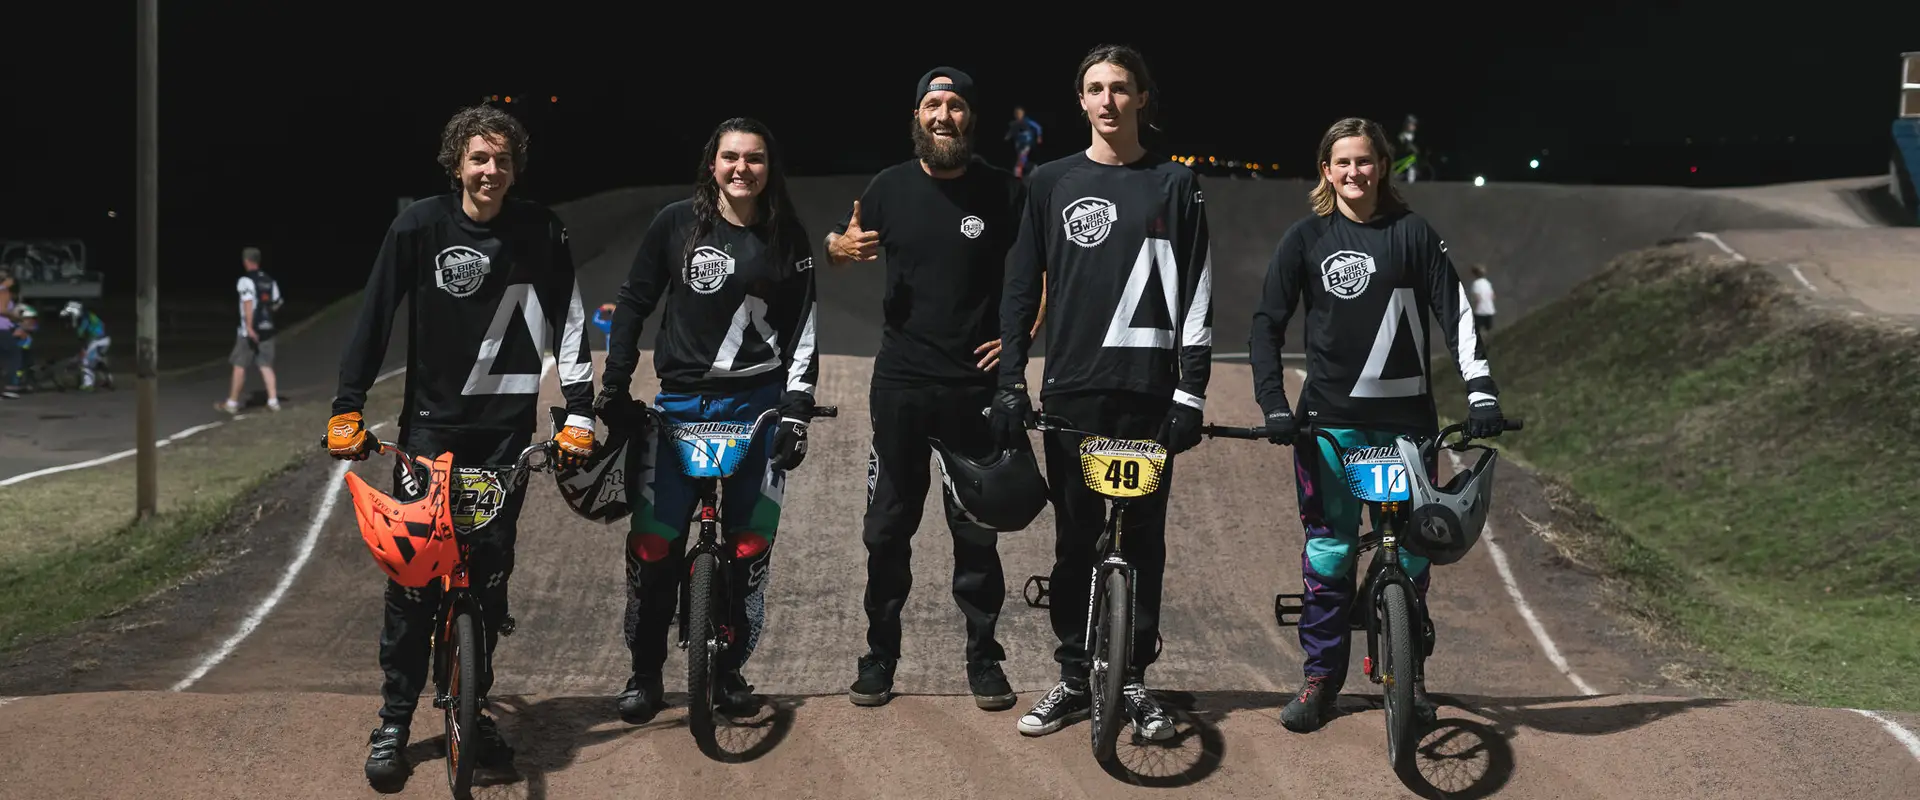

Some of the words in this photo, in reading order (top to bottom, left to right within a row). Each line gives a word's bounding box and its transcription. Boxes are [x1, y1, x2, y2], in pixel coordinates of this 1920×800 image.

[1085, 207, 1109, 222] BIKE
[1083, 215, 1111, 231] WORX
[457, 260, 483, 272] BIKE
[699, 267, 728, 278] WORX
[703, 260, 728, 270] BIKE
[1343, 260, 1368, 274] BIKE
[453, 267, 484, 280] WORX
[1341, 267, 1370, 282] WORX
[691, 439, 727, 468] 47
[1080, 439, 1161, 455] SOUTHLAKE
[1344, 446, 1401, 466] SOUTHL
[1105, 459, 1140, 490] 49
[1371, 465, 1407, 493] 10
